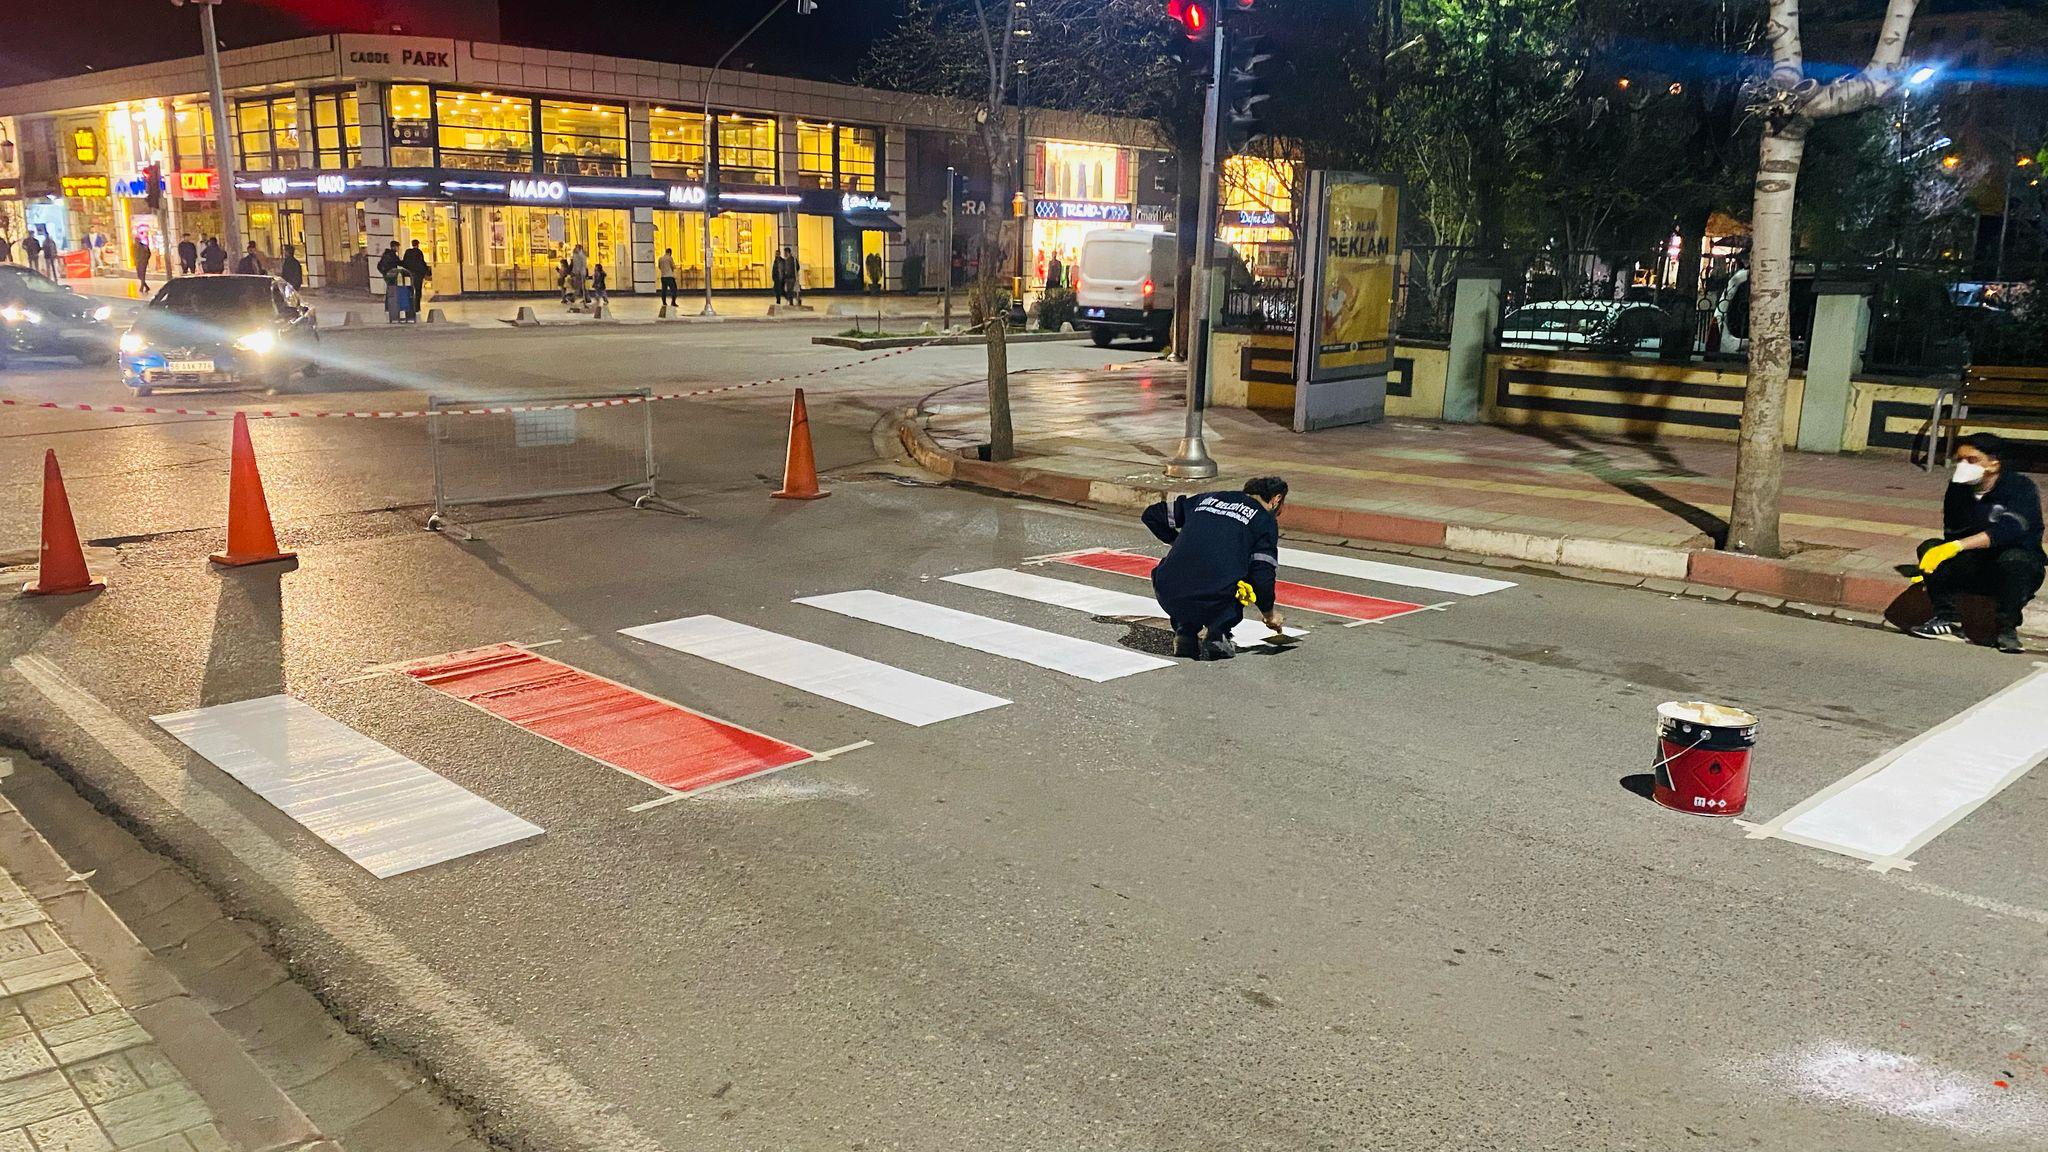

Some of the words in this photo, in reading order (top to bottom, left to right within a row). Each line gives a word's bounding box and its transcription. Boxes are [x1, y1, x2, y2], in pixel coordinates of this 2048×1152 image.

[402, 49, 449, 68] PARK
[509, 179, 564, 199] MADO
[669, 186, 706, 204] MAD
[1328, 236, 1389, 257] REKLAM
